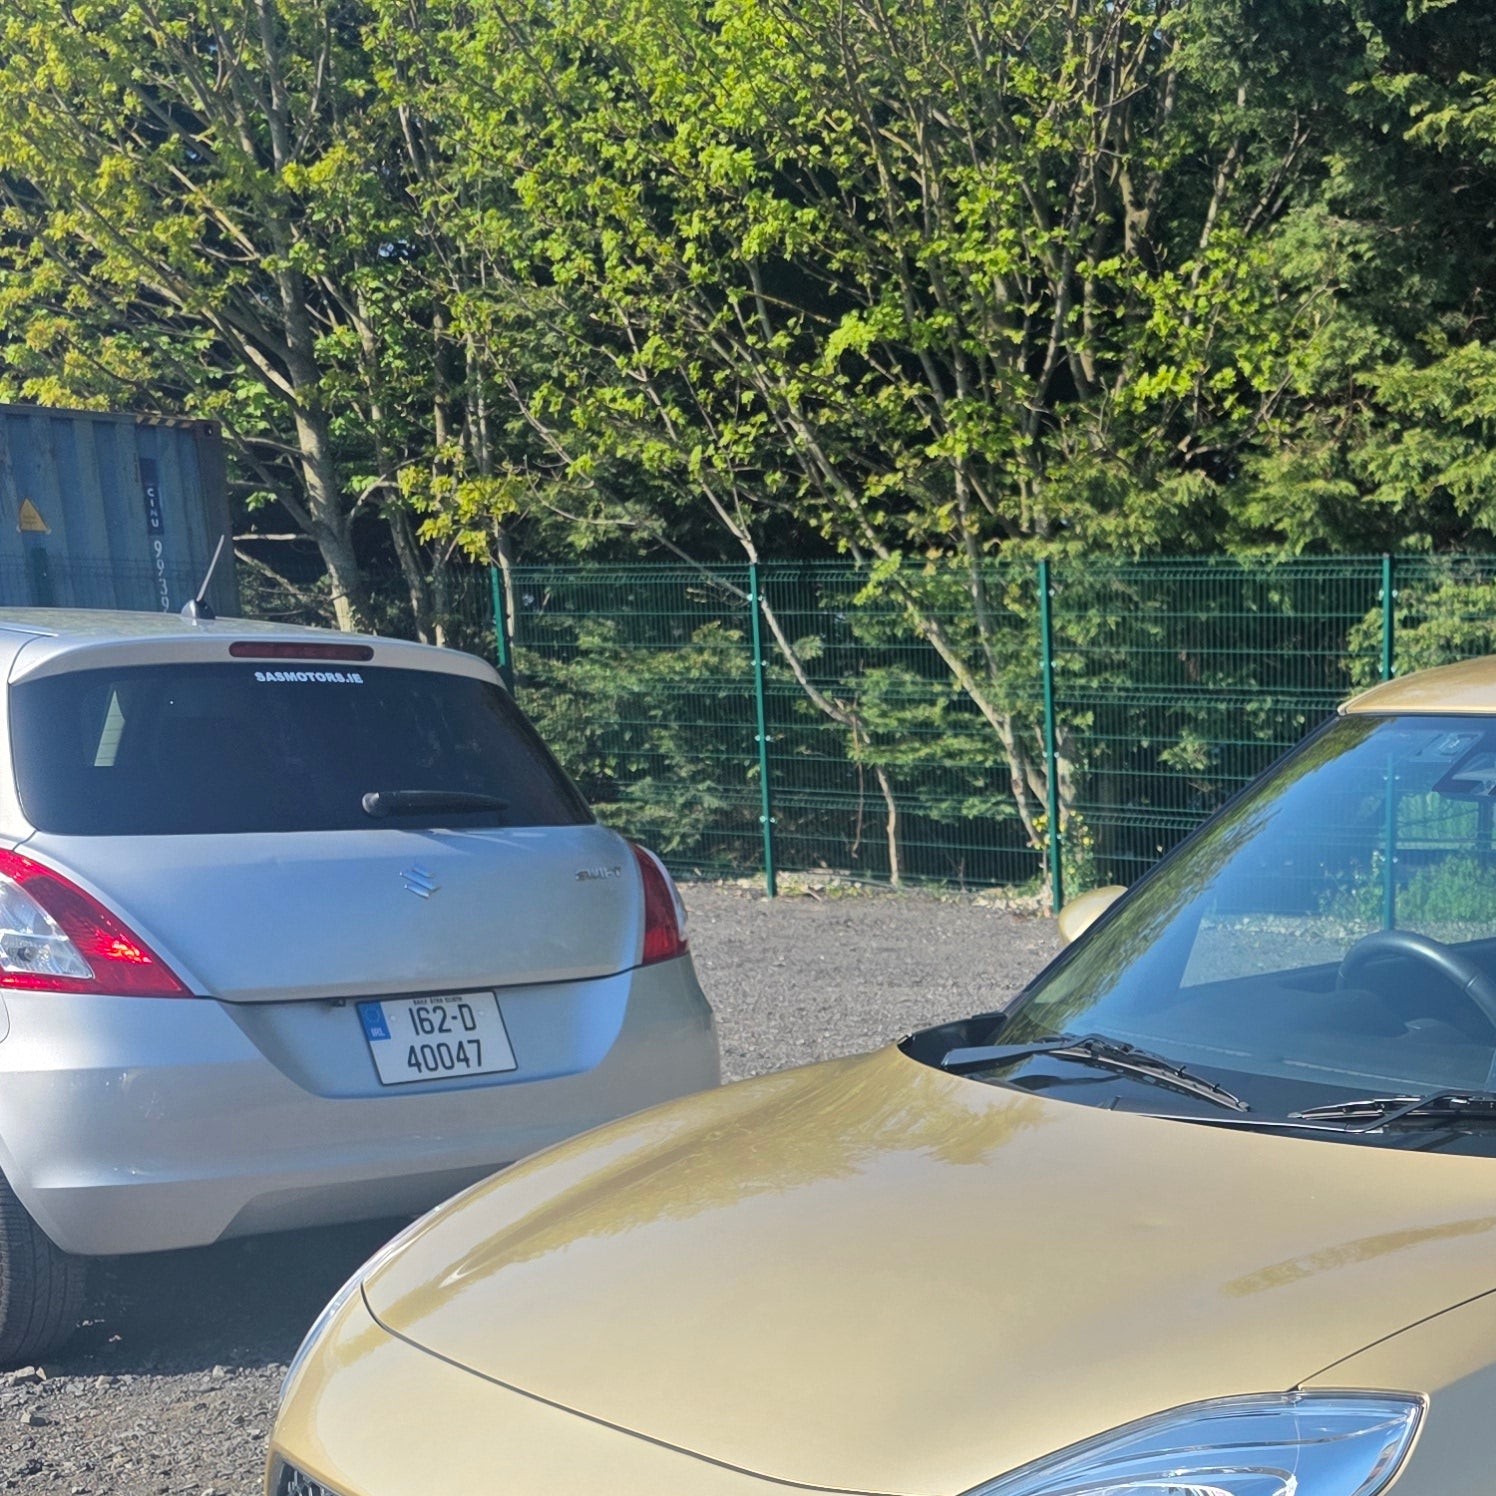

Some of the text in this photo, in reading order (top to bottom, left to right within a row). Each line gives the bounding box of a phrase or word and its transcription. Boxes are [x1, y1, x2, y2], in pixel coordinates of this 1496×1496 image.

[254, 671, 364, 684] SASMOTORS.IE
[408, 1003, 477, 1036] 162-D
[407, 1039, 482, 1073] 40047
